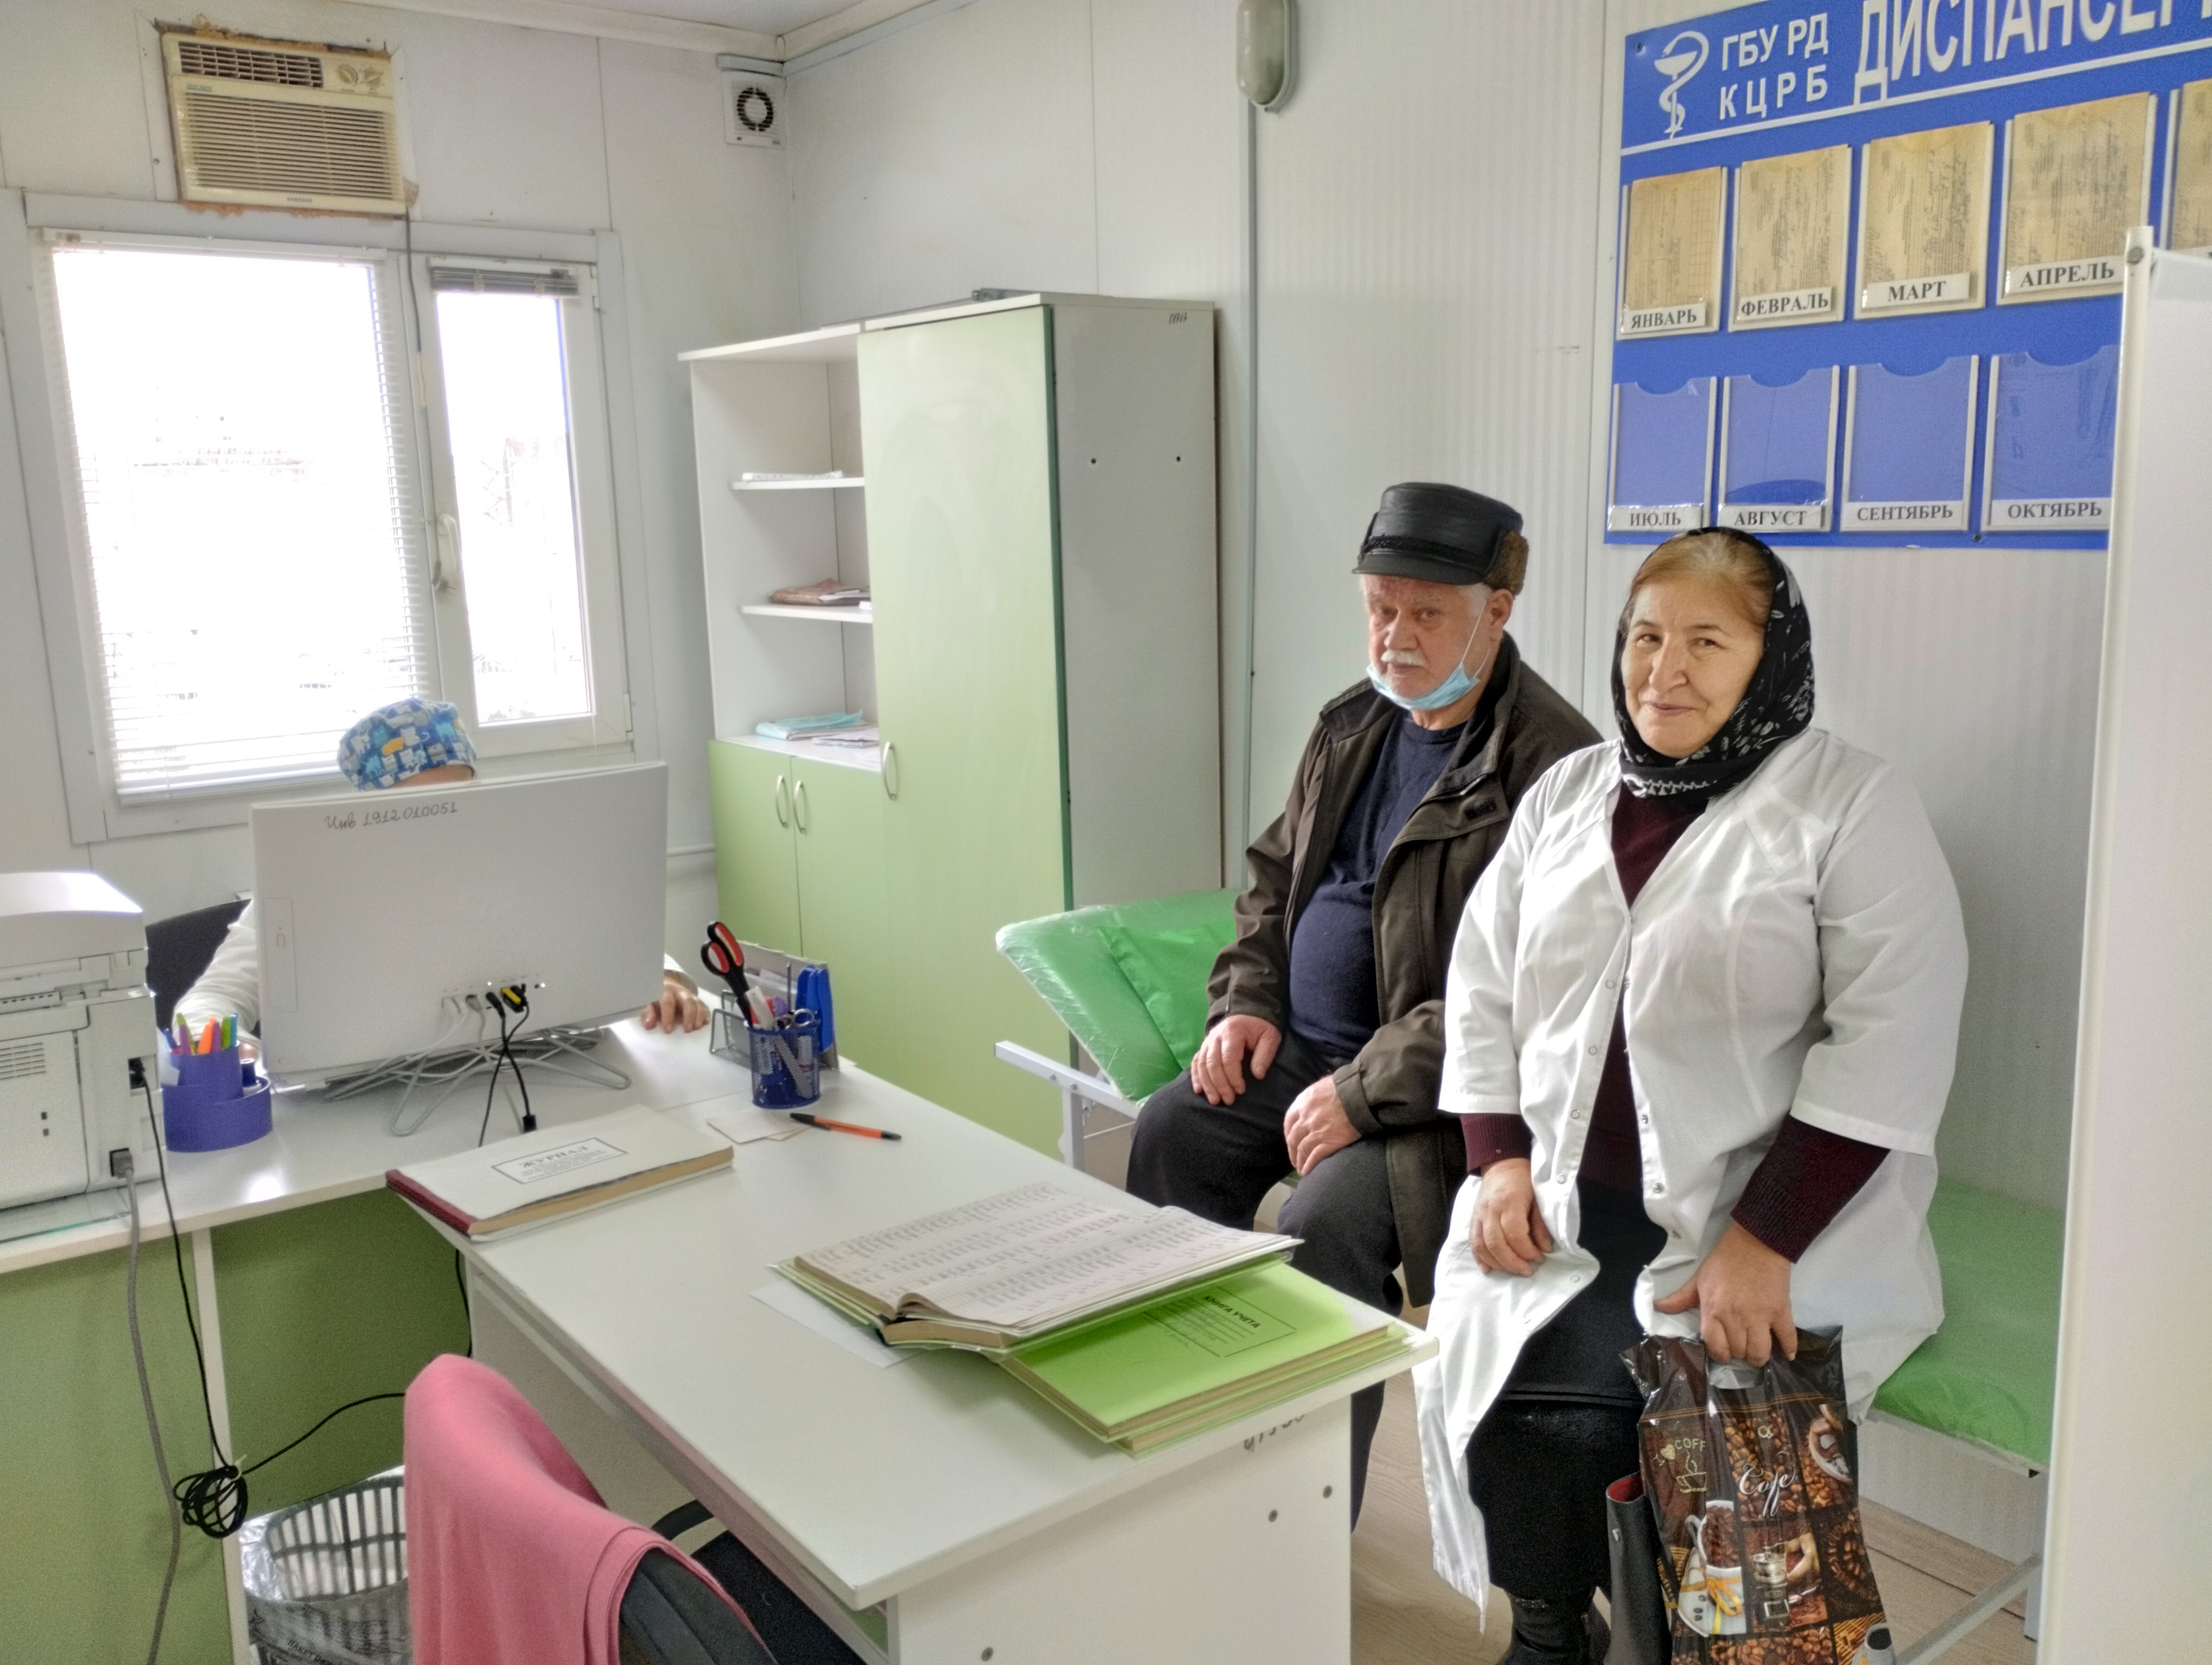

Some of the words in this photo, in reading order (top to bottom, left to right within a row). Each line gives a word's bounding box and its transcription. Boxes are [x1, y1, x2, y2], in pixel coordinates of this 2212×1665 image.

[1722, 25, 1779, 71] ГБУ
[1788, 13, 1829, 59] РД
[2019, 262, 2115, 288] АПРЕЛЬ
[1887, 280, 1947, 302] МАРТ
[1741, 293, 1829, 316] ФЕВРАЛЬ
[1631, 308, 1697, 329] ЯНВАРЬ
[1630, 512, 1681, 526] ИЮЛЬ
[1734, 511, 1807, 525] АВГУСТ
[1857, 505, 1953, 520] СЕНТЯБРЬ
[2008, 502, 2102, 518] ОКТЯБРЬ
